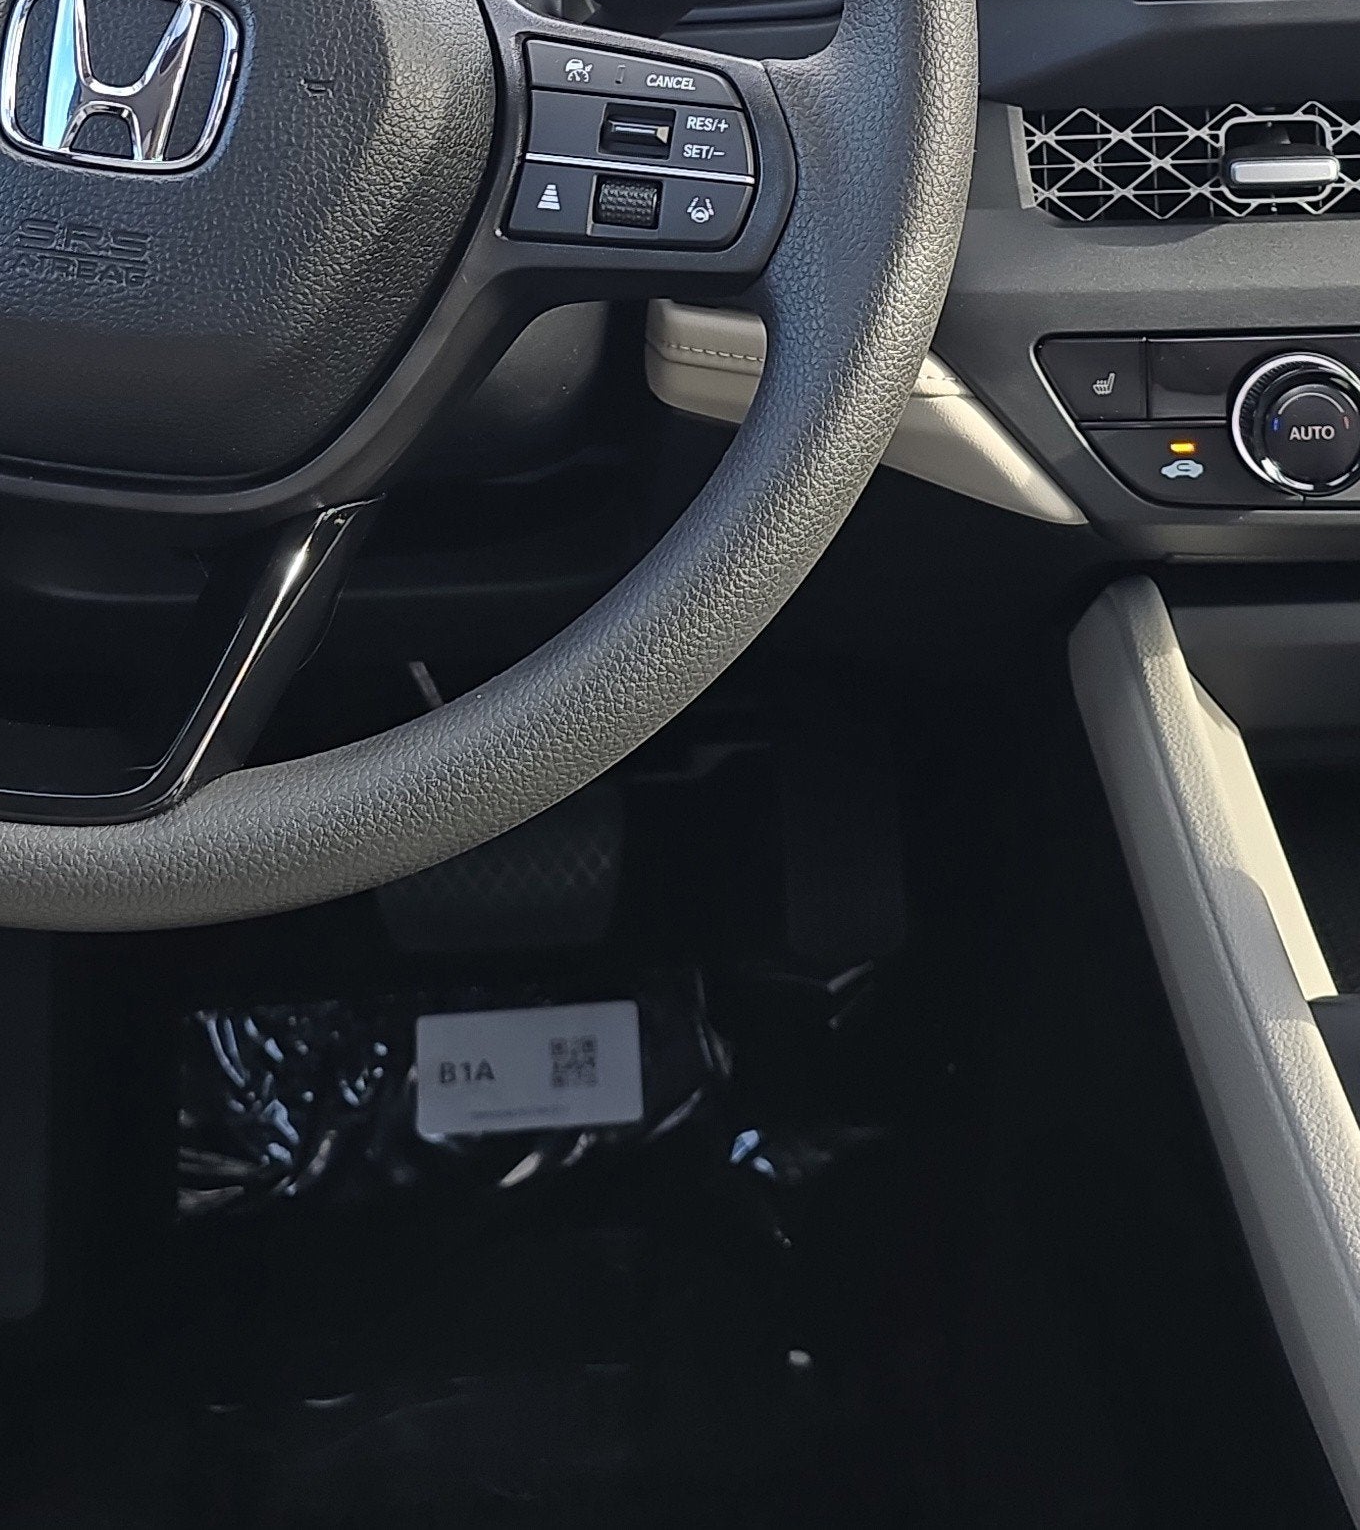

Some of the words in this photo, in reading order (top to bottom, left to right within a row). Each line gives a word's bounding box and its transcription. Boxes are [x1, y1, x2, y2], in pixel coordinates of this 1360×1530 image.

[645, 74, 696, 91] CANCEL
[1289, 426, 1335, 441] AUTO
[439, 1058, 496, 1085] B1A
